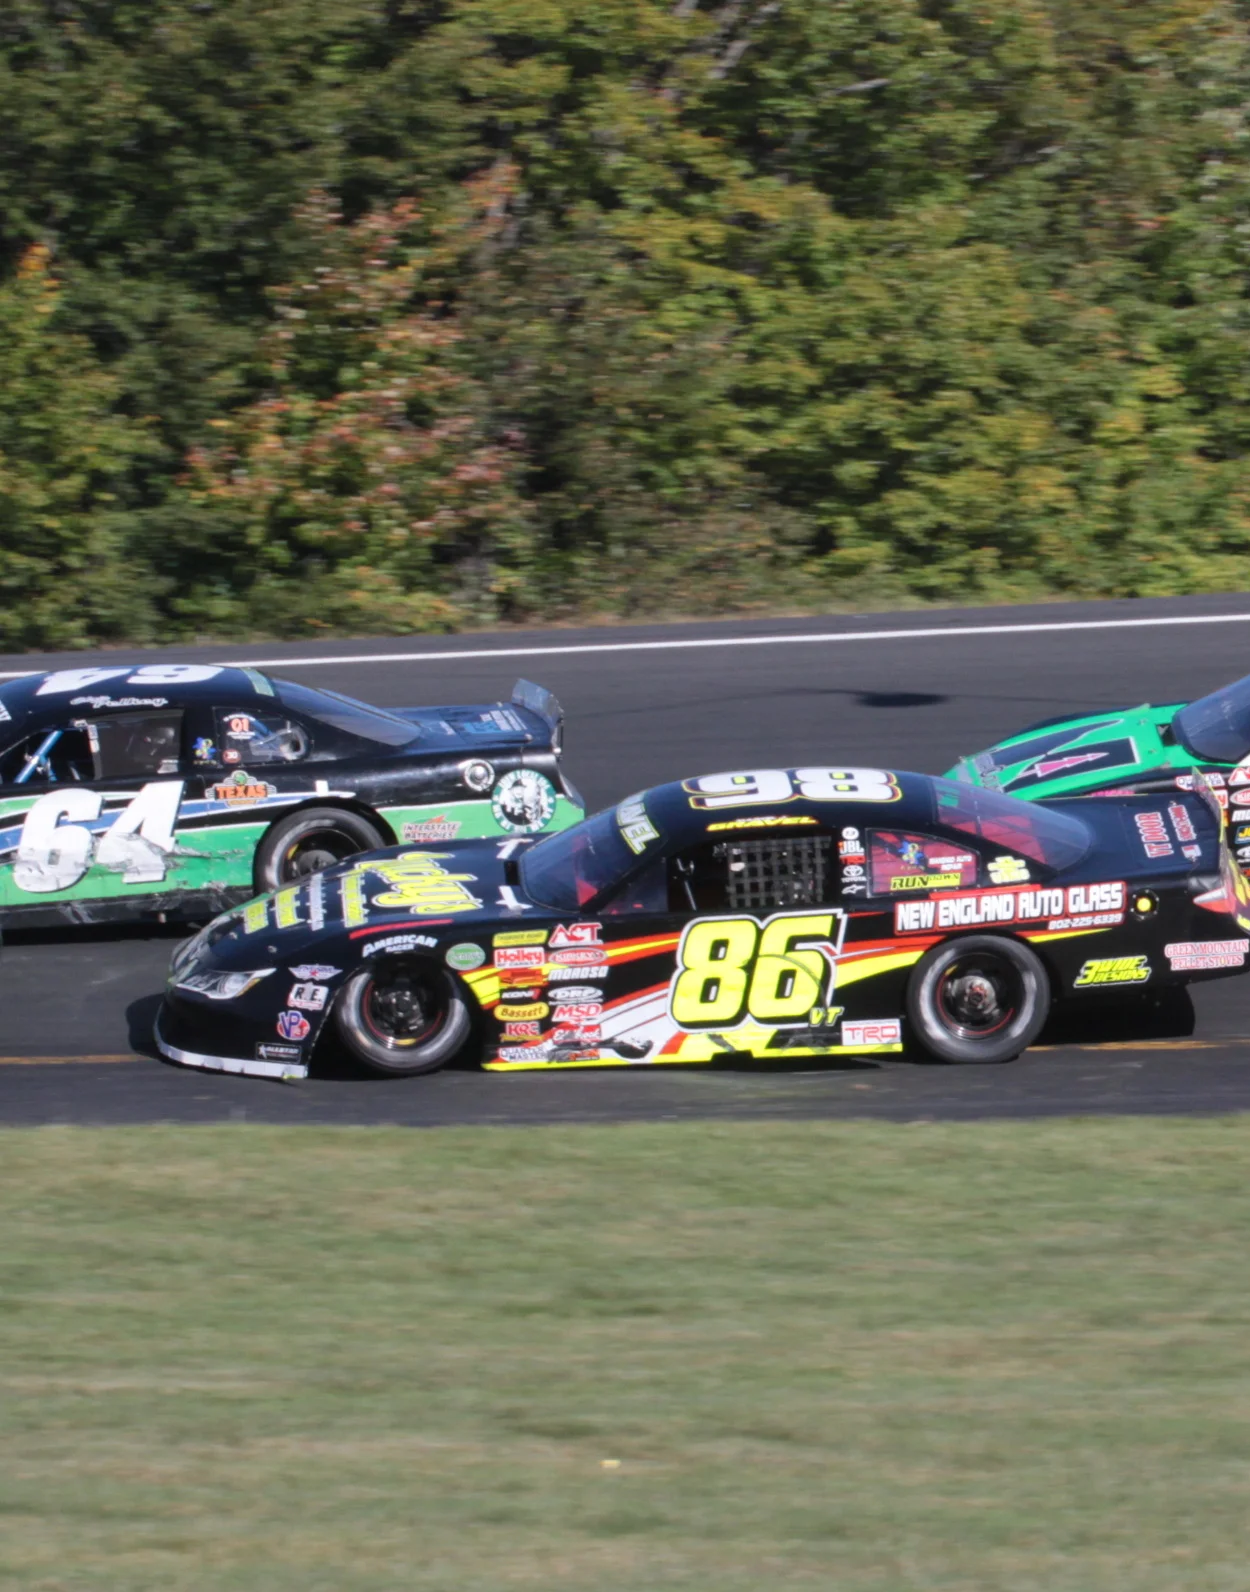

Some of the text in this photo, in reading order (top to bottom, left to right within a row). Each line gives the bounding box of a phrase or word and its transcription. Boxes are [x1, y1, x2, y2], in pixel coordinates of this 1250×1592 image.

[216, 784, 268, 799] TEXAS
[403, 822, 457, 831] INTERSTATE
[12, 781, 185, 893] 64
[404, 832, 455, 840] BATTERIES
[897, 883, 1123, 931] NEW ENGLAND AUTO GLASS
[362, 934, 438, 957] AMERICAN
[1165, 940, 1249, 957] GREEN MOUNTAIN
[497, 948, 541, 965] Holley
[1171, 954, 1244, 970] PELLET STOVES
[548, 966, 609, 980] MOROSO
[668, 908, 847, 1033] 86
[500, 1005, 543, 1017] Bassett
[555, 1004, 602, 1018] MSD
[808, 1007, 844, 1026] VT
[506, 1022, 539, 1036] KRC
[844, 1026, 898, 1041] TRD
